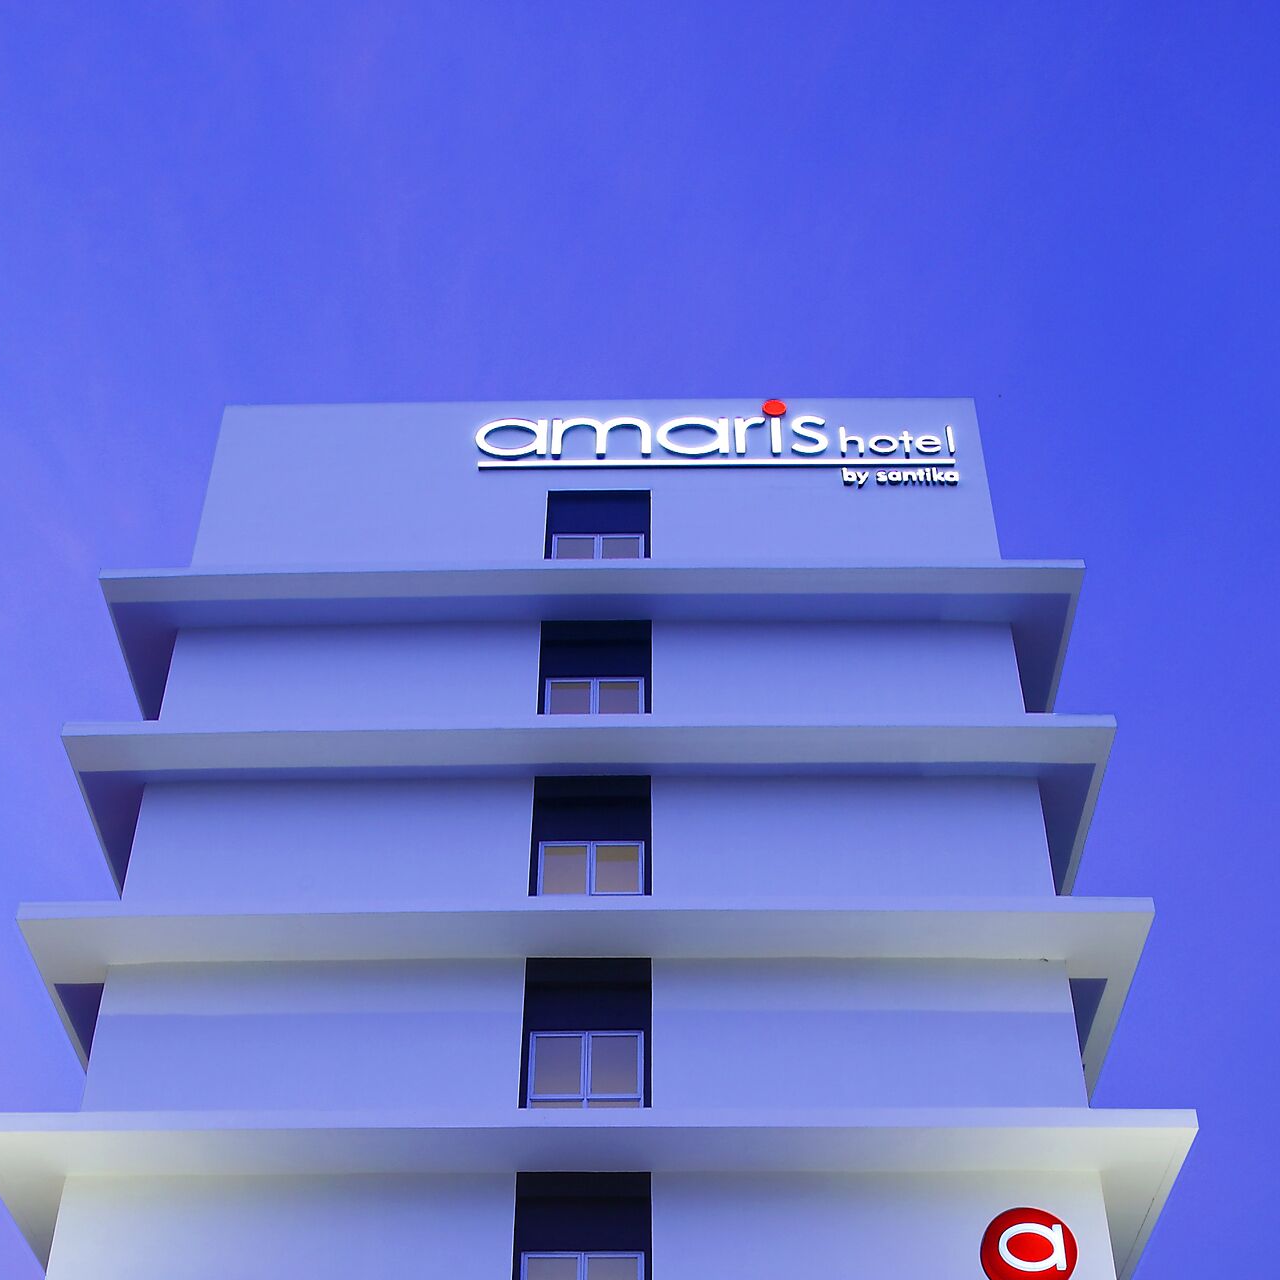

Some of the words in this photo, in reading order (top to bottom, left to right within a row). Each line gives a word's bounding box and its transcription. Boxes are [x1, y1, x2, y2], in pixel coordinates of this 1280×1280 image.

[475, 399, 829, 460] amaris
[839, 425, 956, 457] hotel
[841, 466, 870, 488] by
[875, 466, 959, 487] santika
[998, 1222, 1067, 1272] a
